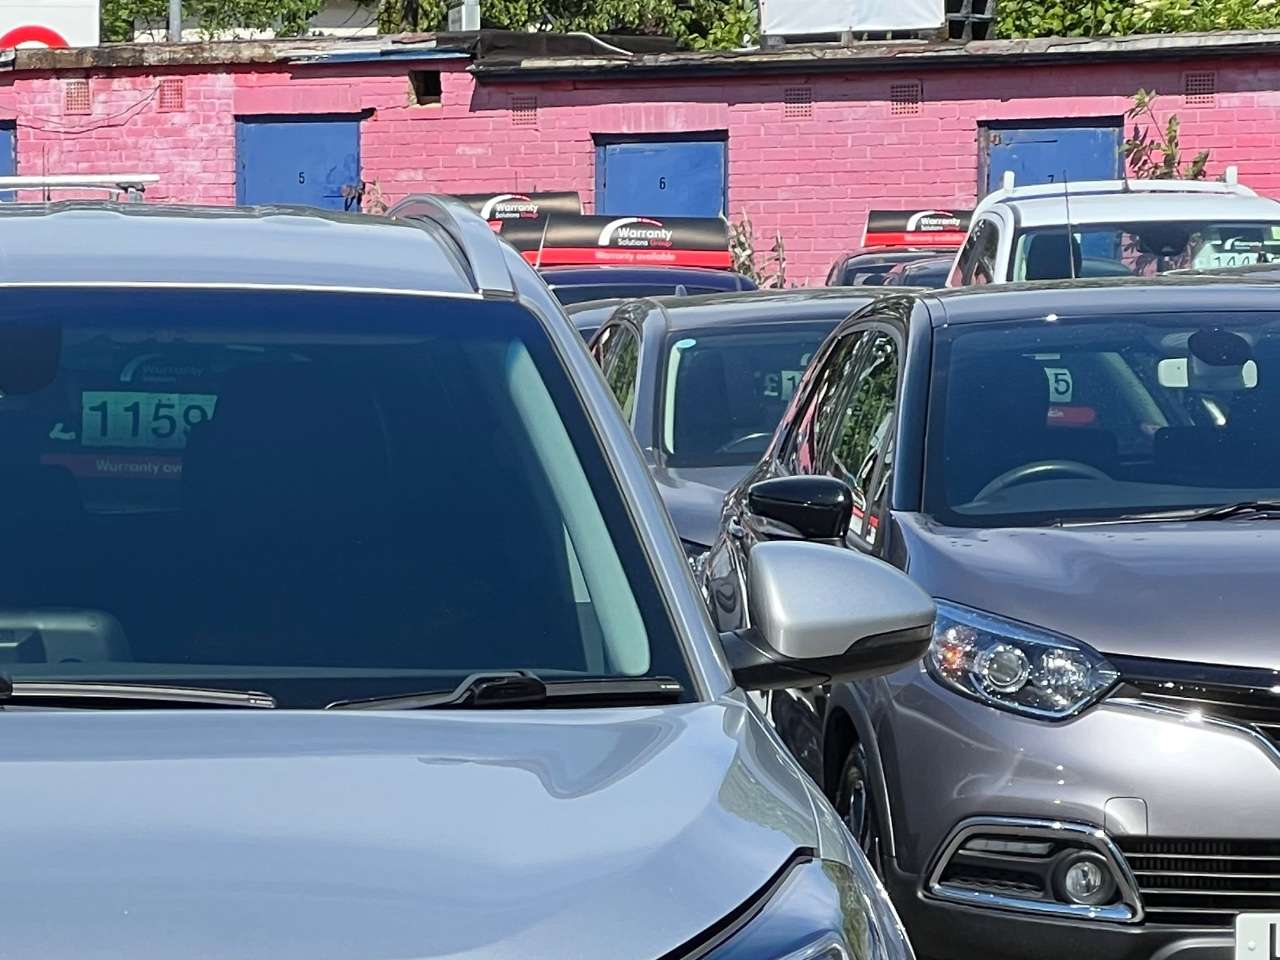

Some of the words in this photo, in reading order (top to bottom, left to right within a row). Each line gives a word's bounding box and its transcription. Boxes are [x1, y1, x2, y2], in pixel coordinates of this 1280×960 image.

[298, 171, 305, 185] 5
[659, 176, 666, 190] 6
[495, 203, 538, 214] Warranty
[617, 227, 673, 241] Warranty
[617, 238, 649, 247] Solutions
[1053, 372, 1071, 396] 5
[96, 459, 161, 477] Warranty
